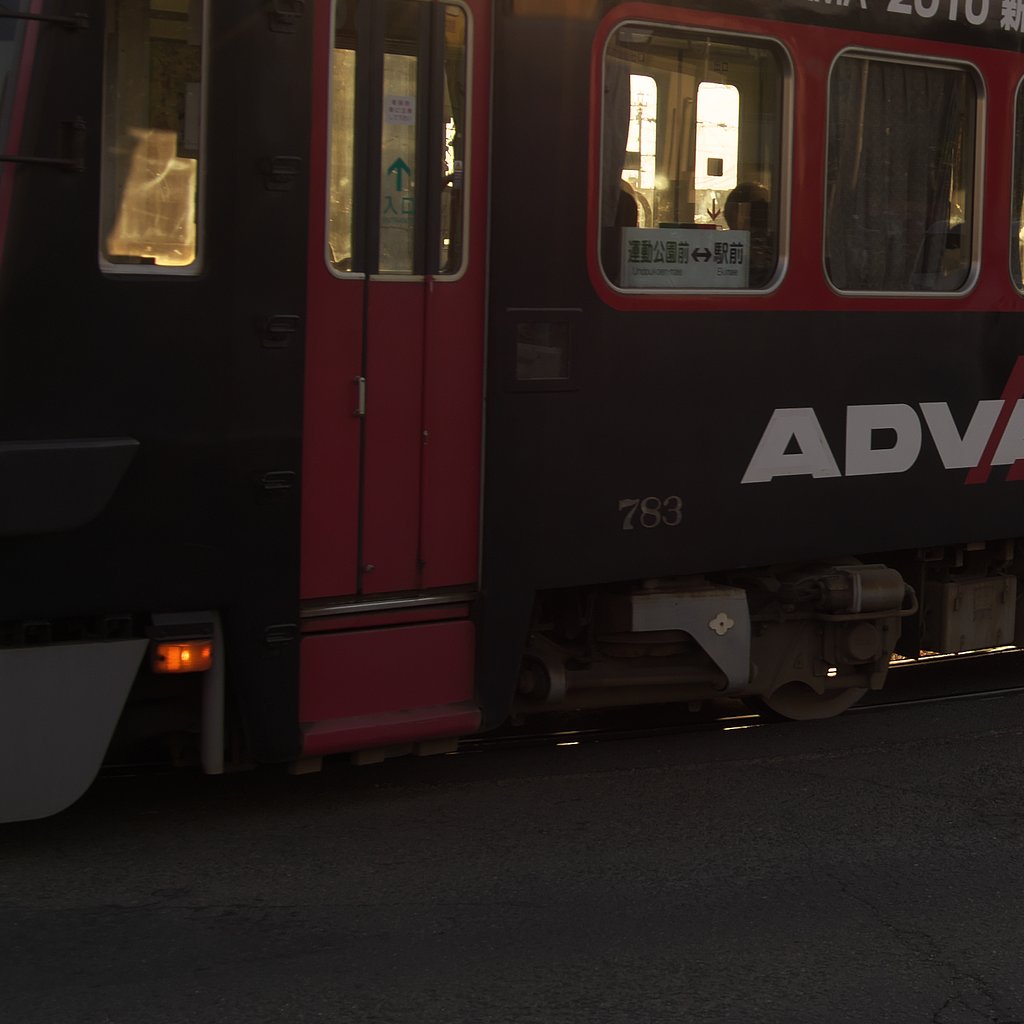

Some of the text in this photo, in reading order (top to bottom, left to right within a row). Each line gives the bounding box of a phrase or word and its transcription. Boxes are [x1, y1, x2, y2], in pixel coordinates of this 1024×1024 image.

[383, 195, 416, 215] 入口
[628, 240, 744, 265] 運動公園前 駅前
[618, 495, 683, 530] 783
